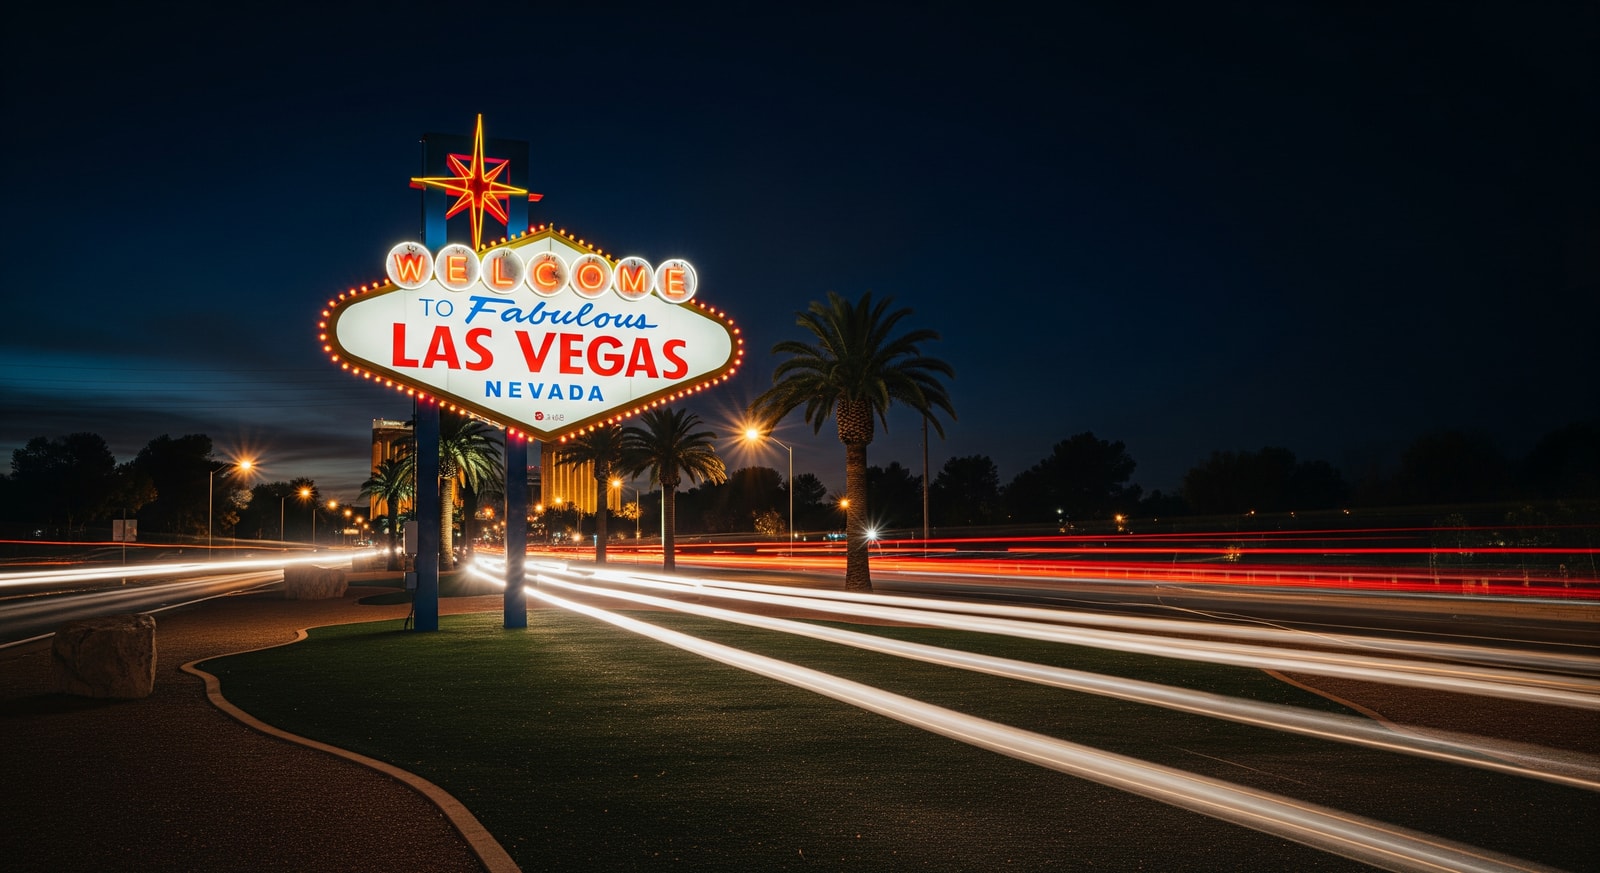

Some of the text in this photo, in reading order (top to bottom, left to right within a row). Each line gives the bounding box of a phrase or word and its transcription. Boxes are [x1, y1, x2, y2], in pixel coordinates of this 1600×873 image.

[393, 252, 686, 296] WELCOME
[419, 295, 658, 330] TO Fabulous
[392, 323, 689, 380] LAS VEGAS
[484, 380, 604, 402] NEVADA
